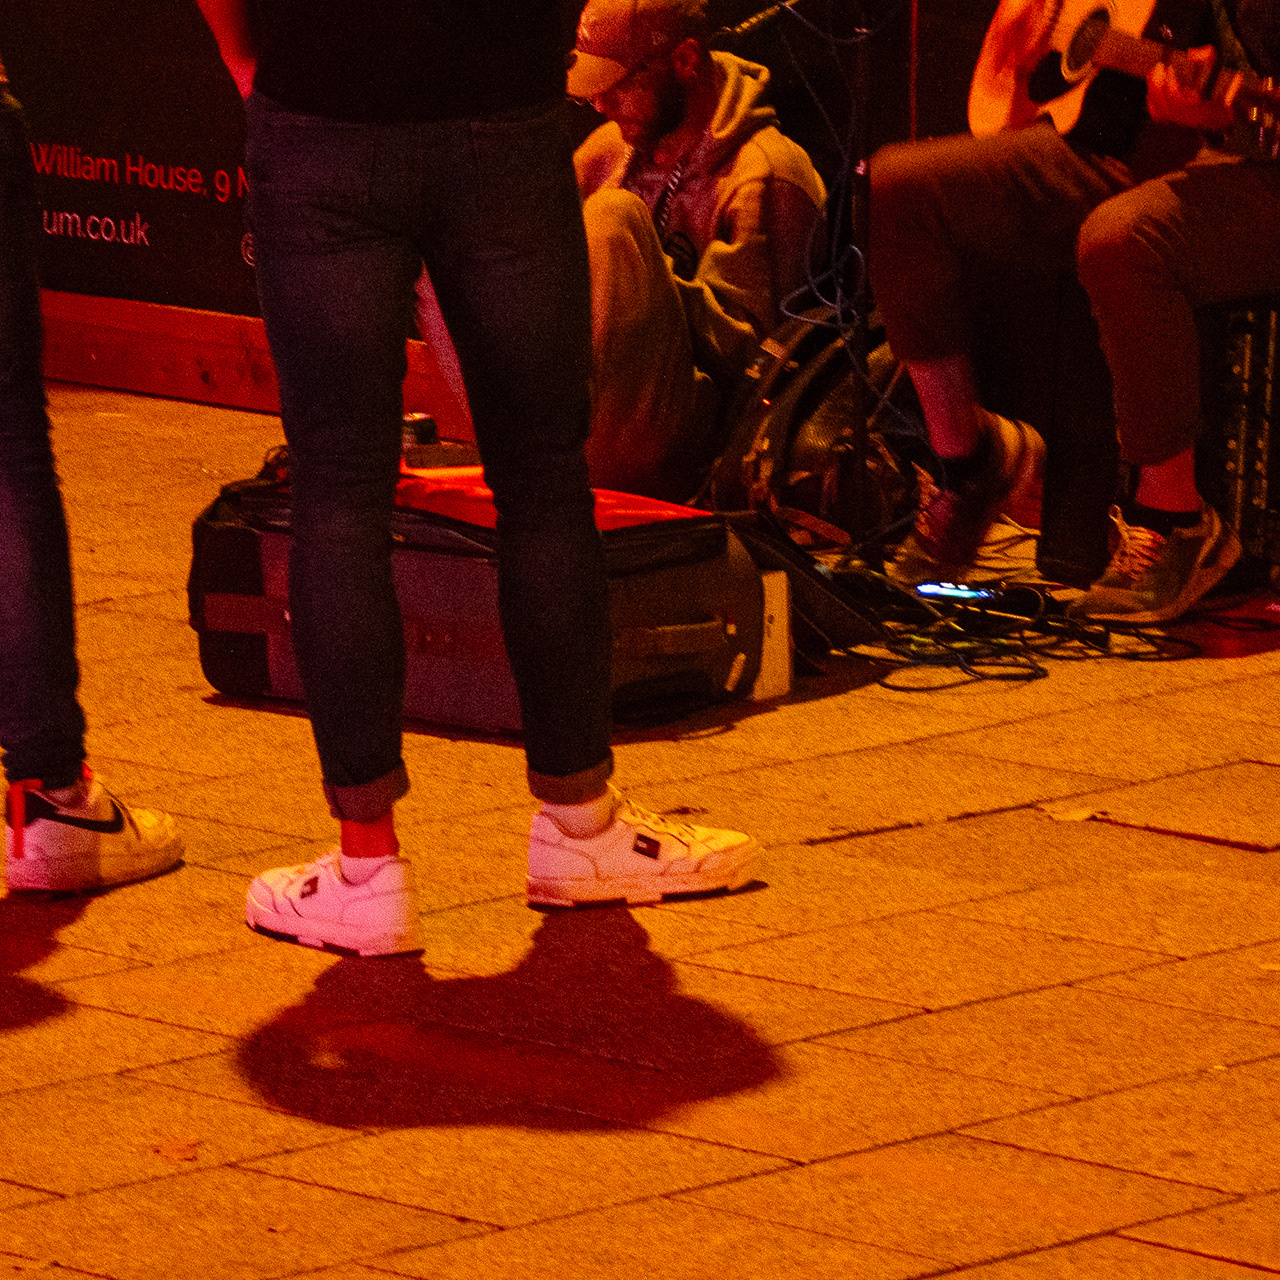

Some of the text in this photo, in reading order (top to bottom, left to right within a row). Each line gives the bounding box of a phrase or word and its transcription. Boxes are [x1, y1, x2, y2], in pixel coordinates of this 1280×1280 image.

[29, 142, 119, 184] William
[214, 169, 231, 203] 9
[42, 210, 150, 247] um.co.uk
